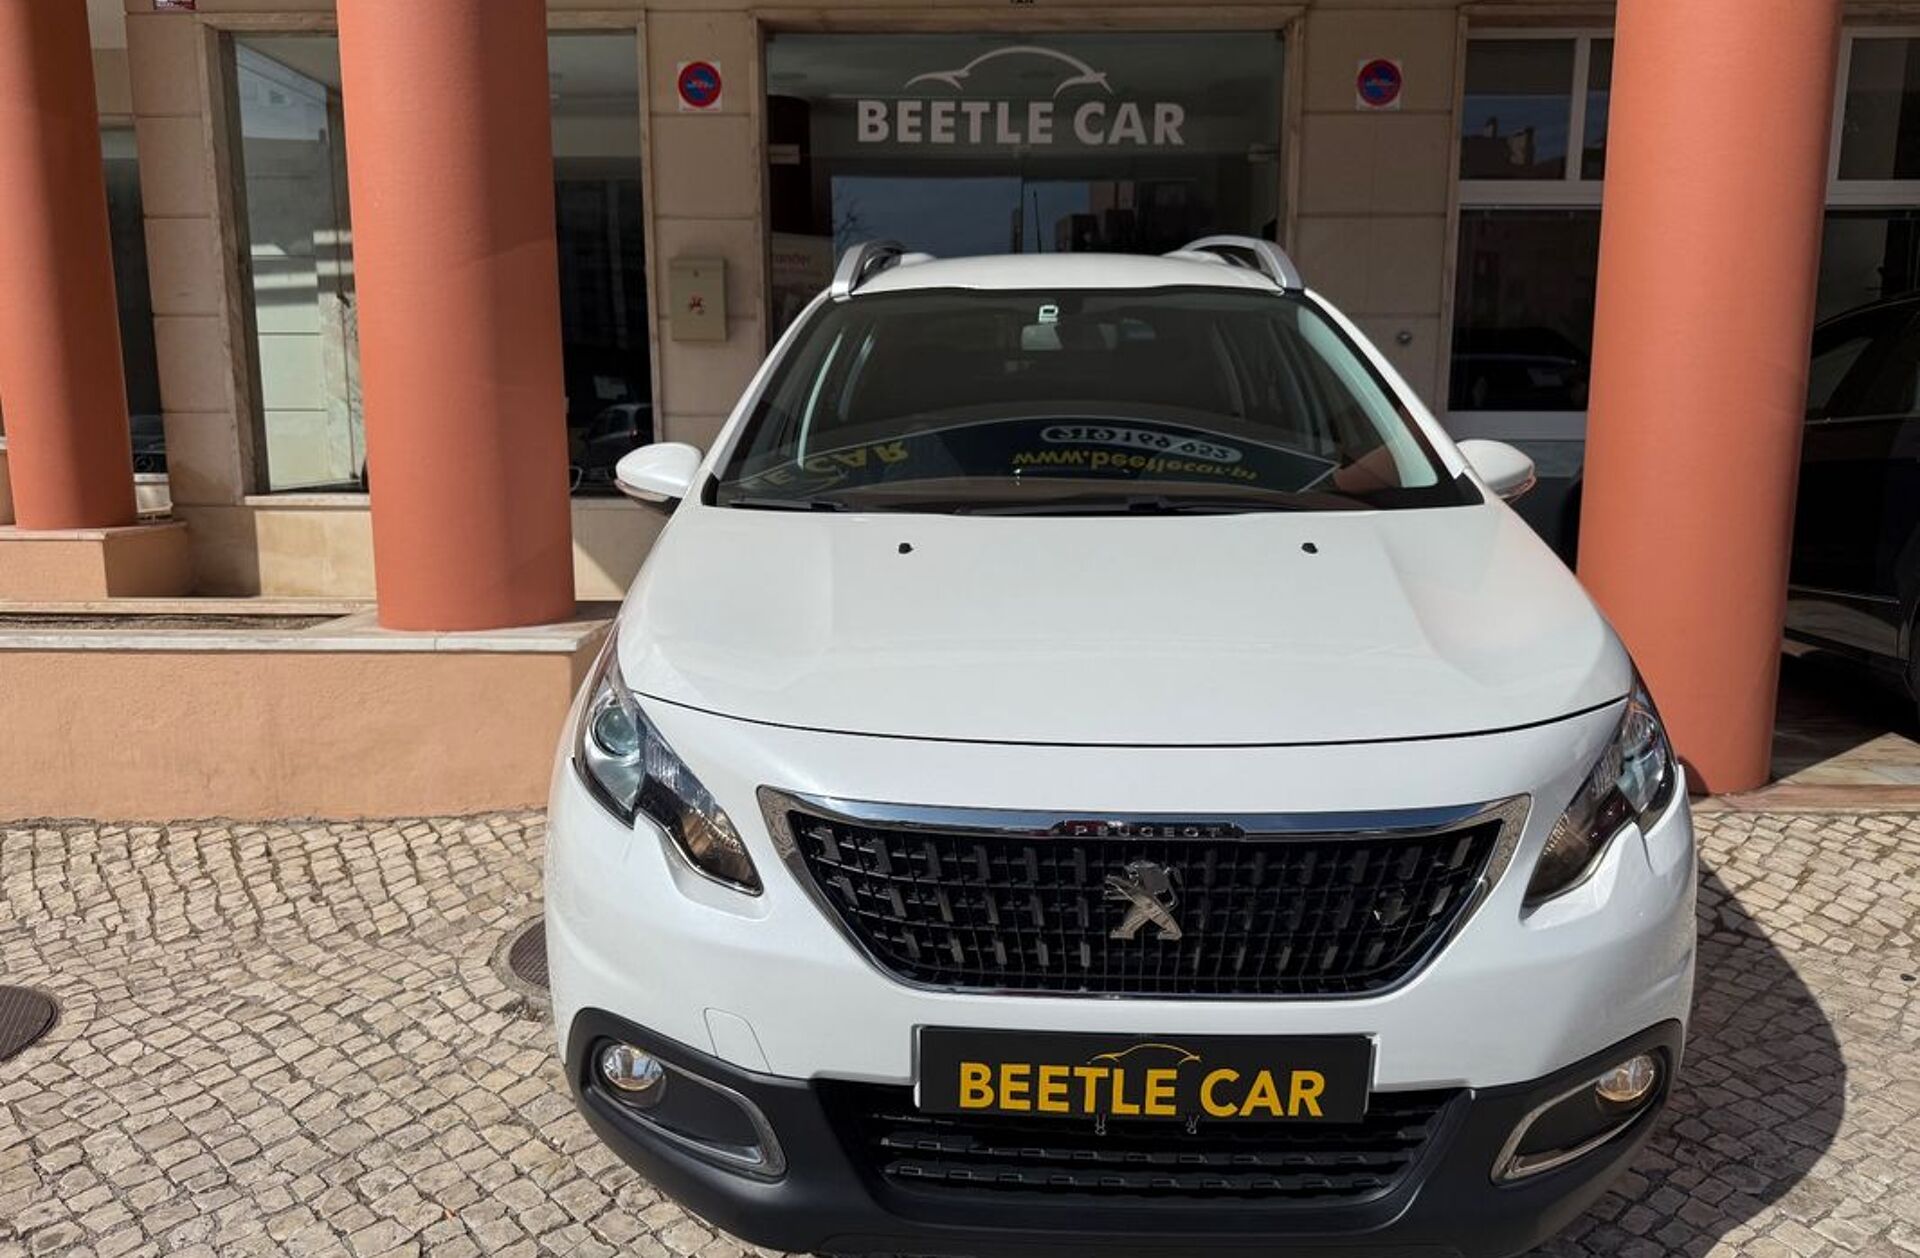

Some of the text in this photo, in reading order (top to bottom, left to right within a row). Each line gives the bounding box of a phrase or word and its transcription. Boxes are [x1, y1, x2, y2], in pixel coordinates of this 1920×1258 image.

[858, 100, 1186, 146] BEETLE CAR
[1074, 825, 1221, 838] PEUGEOT
[959, 1062, 1326, 1118] BEETLE CAR
